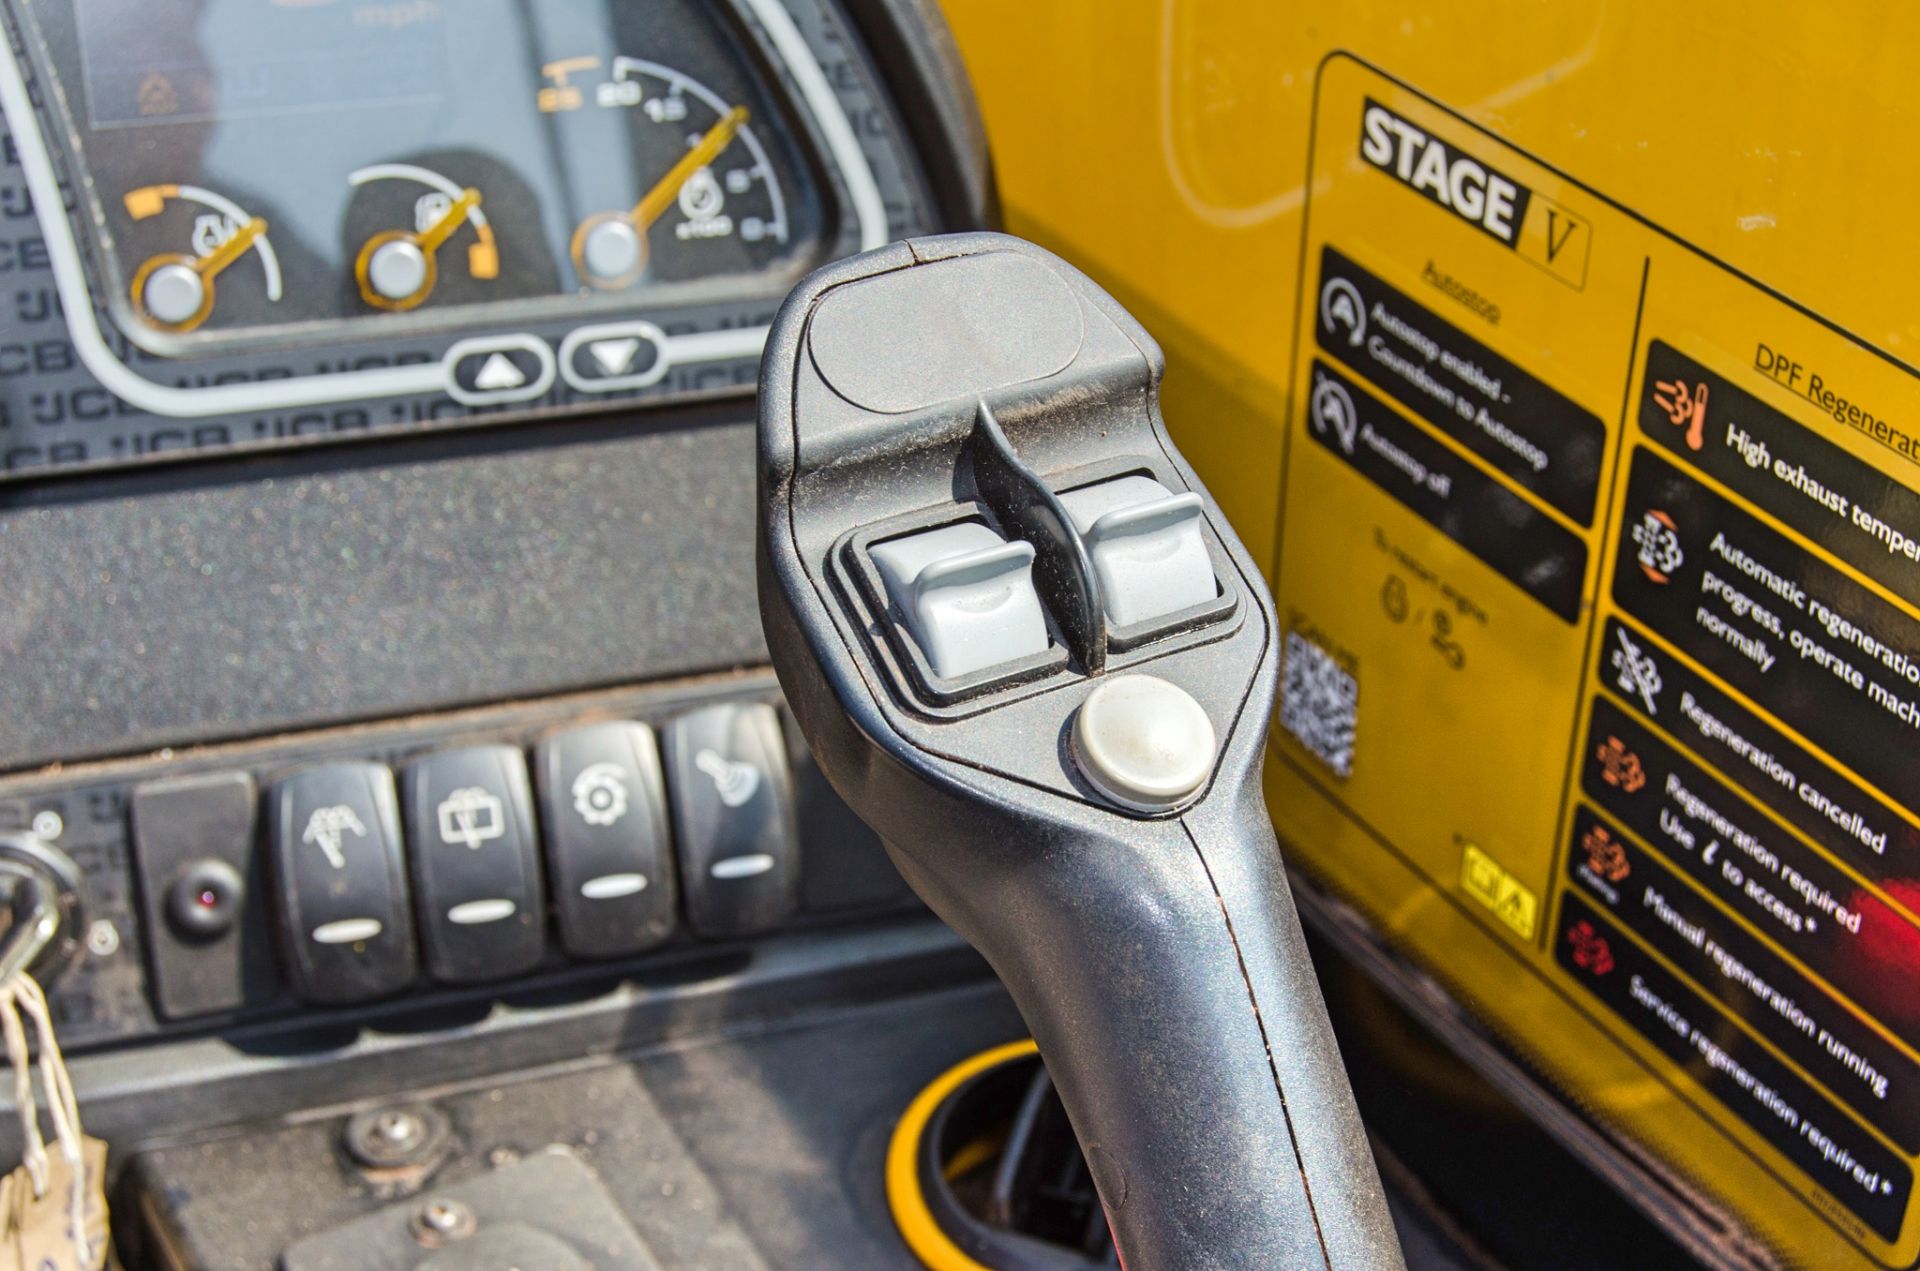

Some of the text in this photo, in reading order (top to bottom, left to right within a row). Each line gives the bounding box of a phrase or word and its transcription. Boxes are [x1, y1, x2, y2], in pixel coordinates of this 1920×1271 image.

[1363, 107, 1577, 264] STAGE V
[1371, 302, 1440, 362] Autostop
[1422, 259, 1501, 325] Autostop
[1368, 335, 1548, 472] Countdown to Autostop
[1755, 342, 1803, 386] DPF
[1360, 422, 1451, 498] Autostop off
[1726, 422, 1771, 469] High
[1774, 462, 1848, 517] exhaust
[1710, 532, 1805, 609] Automatic
[1696, 606, 1776, 673] normally
[1702, 570, 1785, 640] progress,
[1789, 629, 1864, 690] operate
[1680, 691, 1887, 855] Regeneration cancelled
[1660, 807, 1695, 850] Use
[1722, 858, 1743, 886] to
[1665, 772, 1862, 933] Regeneration required
[1643, 885, 1889, 1100] Manual regeneration running
[1629, 973, 1691, 1037] Service
[1690, 1029, 1798, 1128] regeneration
